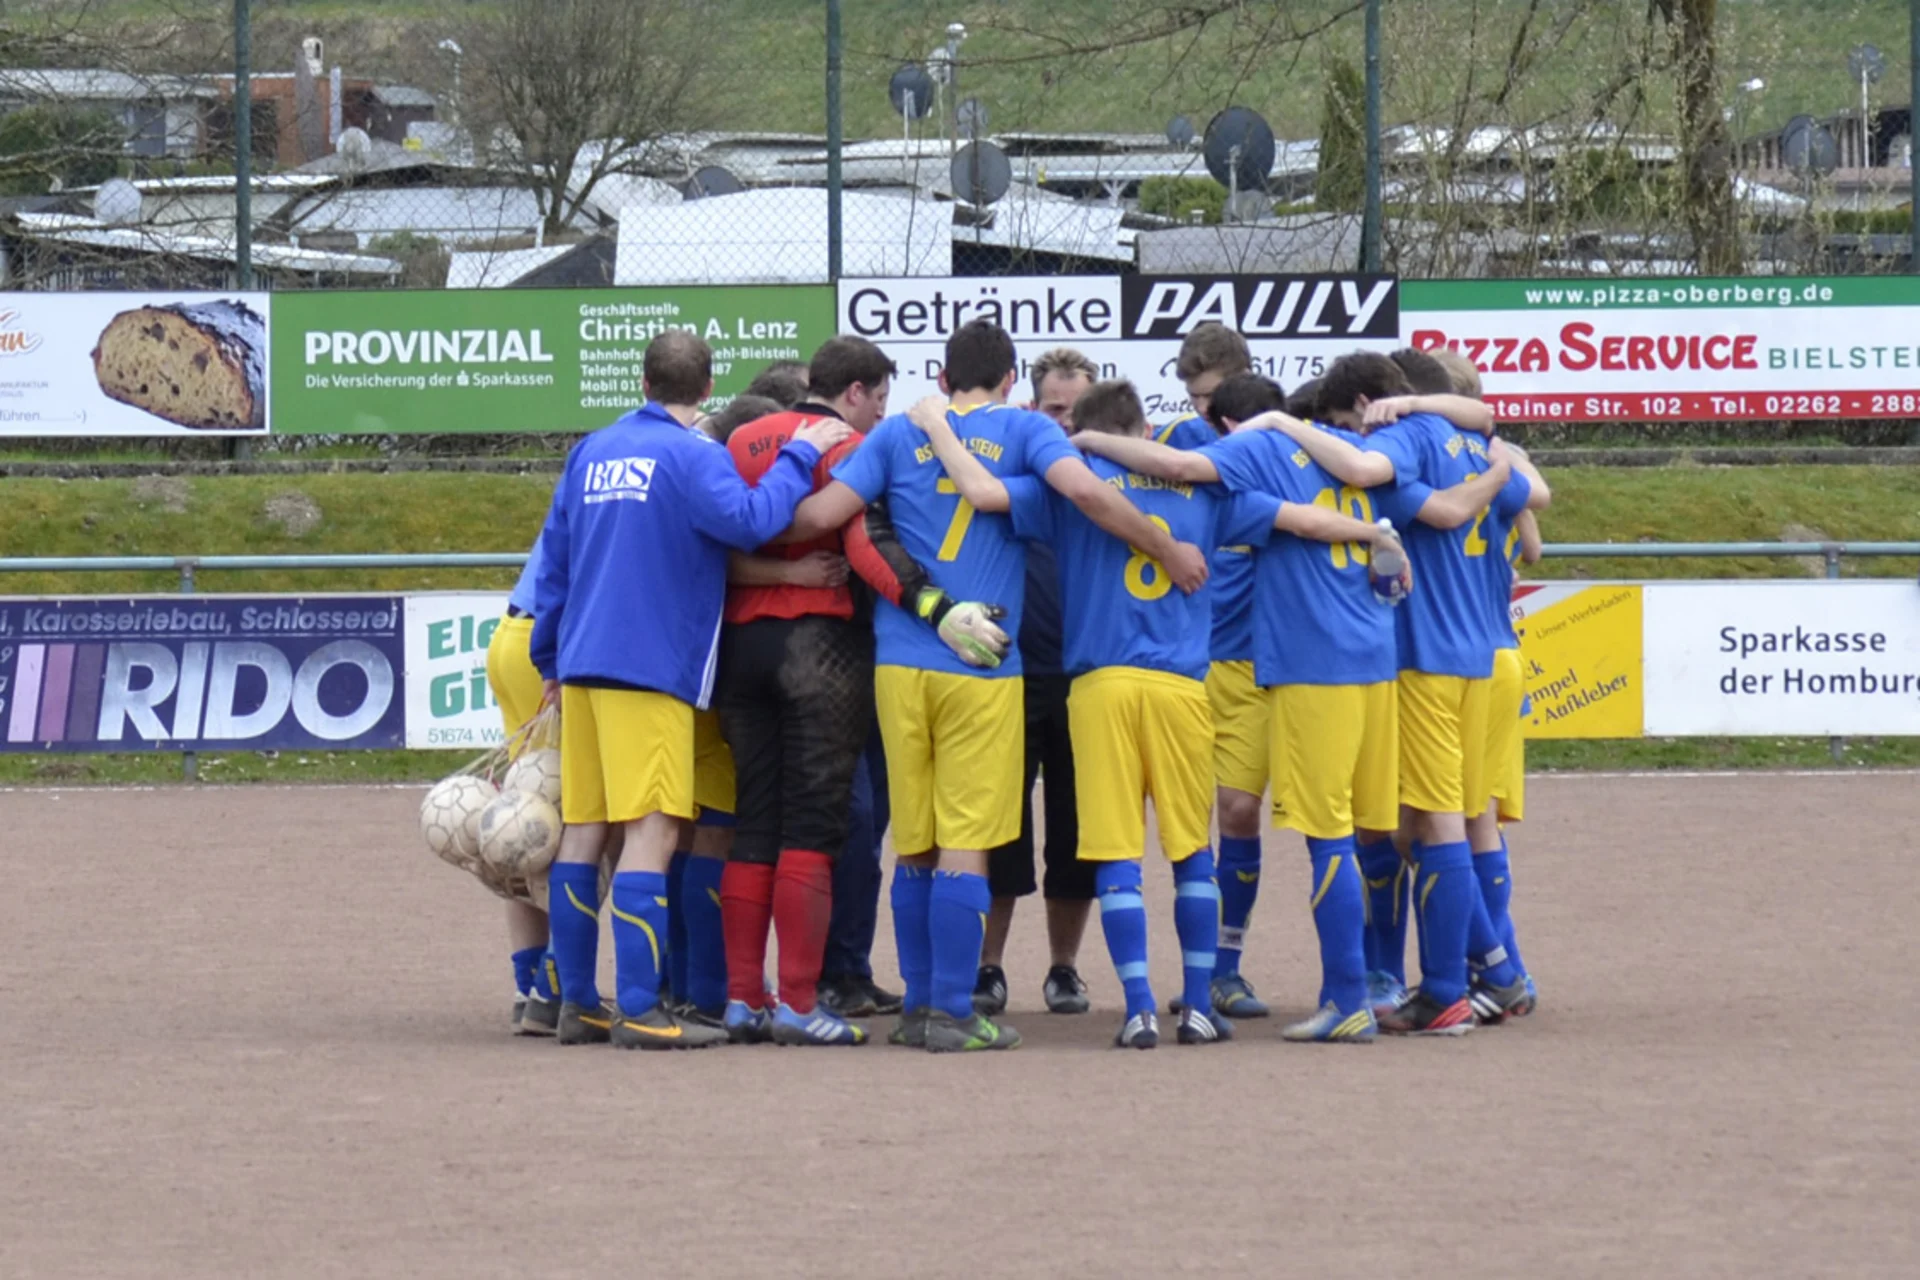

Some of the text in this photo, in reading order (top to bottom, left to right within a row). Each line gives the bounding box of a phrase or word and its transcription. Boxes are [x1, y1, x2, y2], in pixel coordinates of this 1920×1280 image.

[1134, 280, 1395, 335] PAULY
[1525, 284, 1833, 306] www.pizza-oberberg.de
[579, 304, 680, 317] Geschäftsstelle
[848, 287, 1112, 335] Getränke
[704, 318, 730, 340] A.
[738, 318, 798, 340] Lenz
[305, 329, 554, 365] PROVINZIAL
[579, 348, 645, 361] Bahnhofs
[305, 372, 554, 390] Die Versicherung der Sparkassen
[581, 364, 629, 377] Telefon
[580, 379, 618, 392] Mobil
[1585, 398, 1629, 416] Str.
[1641, 397, 1682, 415] 102
[1710, 396, 1755, 415] Tel.
[1765, 395, 1842, 414] 02262
[936, 477, 978, 562] 7
[1123, 514, 1173, 601] 8
[23, 607, 232, 636] Karosseriebau,
[240, 603, 398, 632] Schlosserei
[1720, 625, 1887, 660] Sparkasse
[97, 639, 395, 741] RIDO
[1719, 667, 1774, 694] der
[1544, 673, 1629, 725] Aufkleber
[428, 728, 473, 744] 51674
